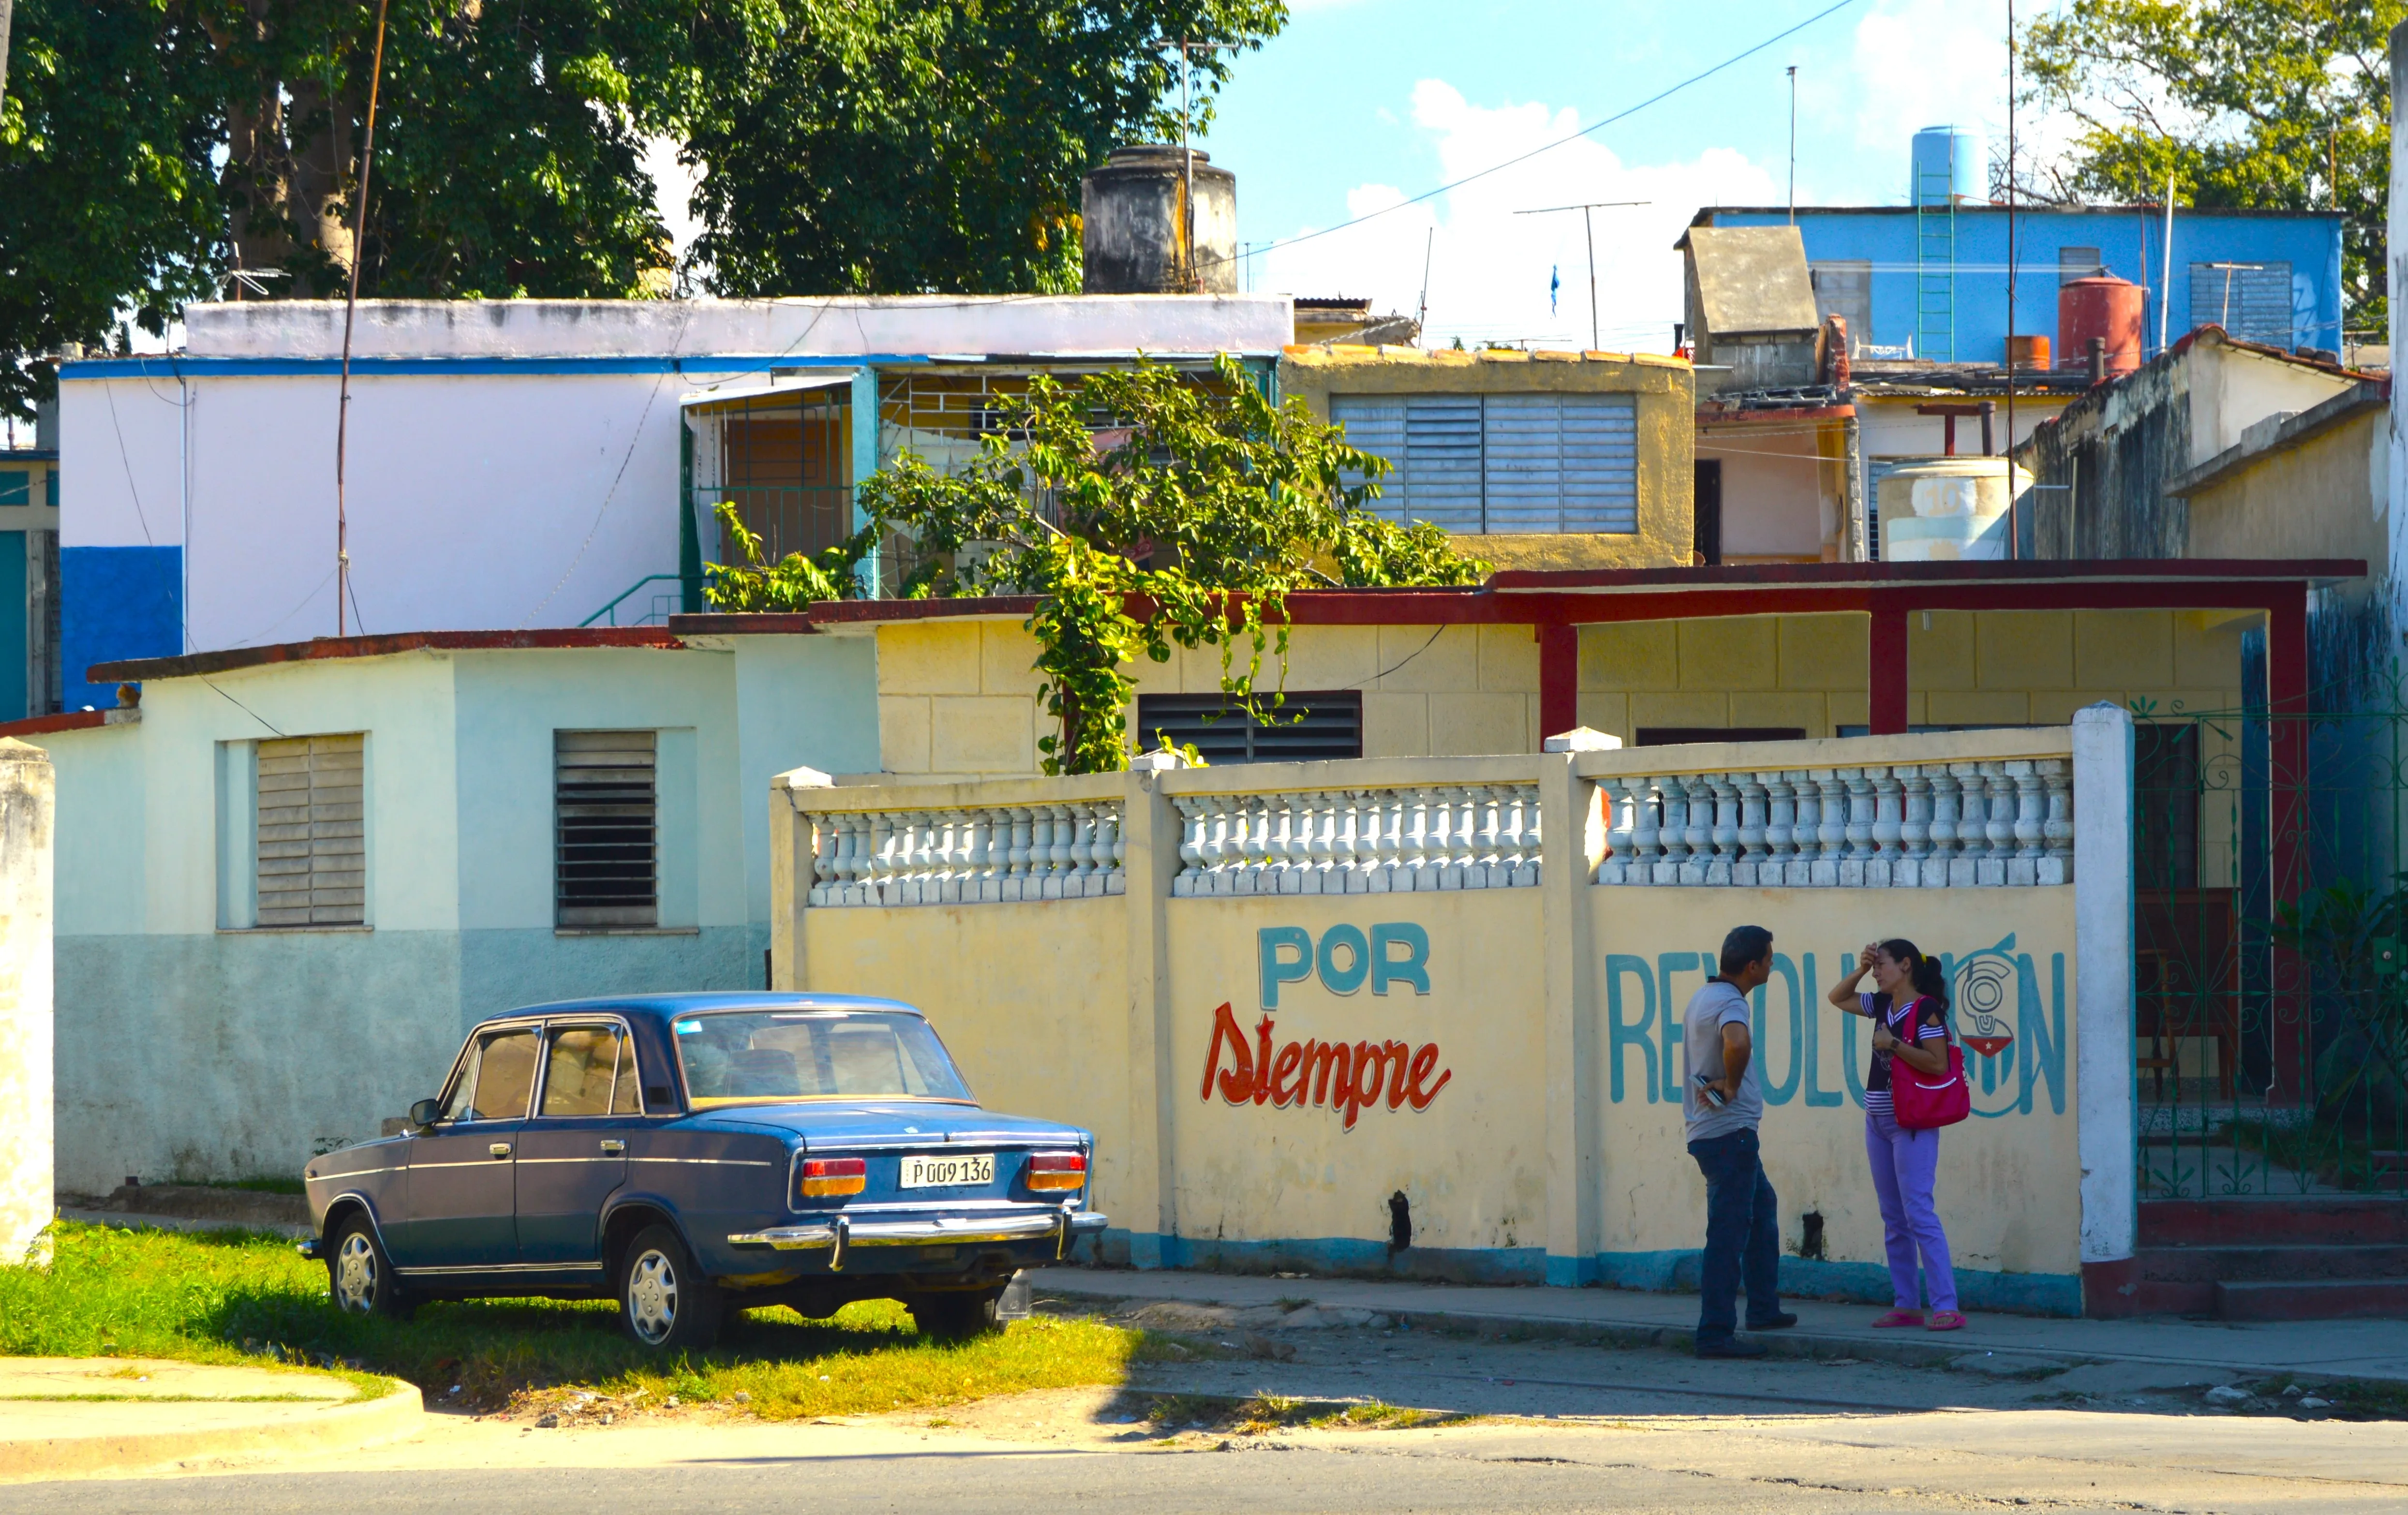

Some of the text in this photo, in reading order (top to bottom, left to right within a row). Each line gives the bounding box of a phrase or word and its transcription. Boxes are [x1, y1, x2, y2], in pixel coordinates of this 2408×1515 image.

[1926, 481, 1961, 516] 10
[1257, 922, 1430, 1010] POR
[1201, 1001, 1451, 1133] Siempre
[1605, 932, 2066, 1118] REOLÓN
